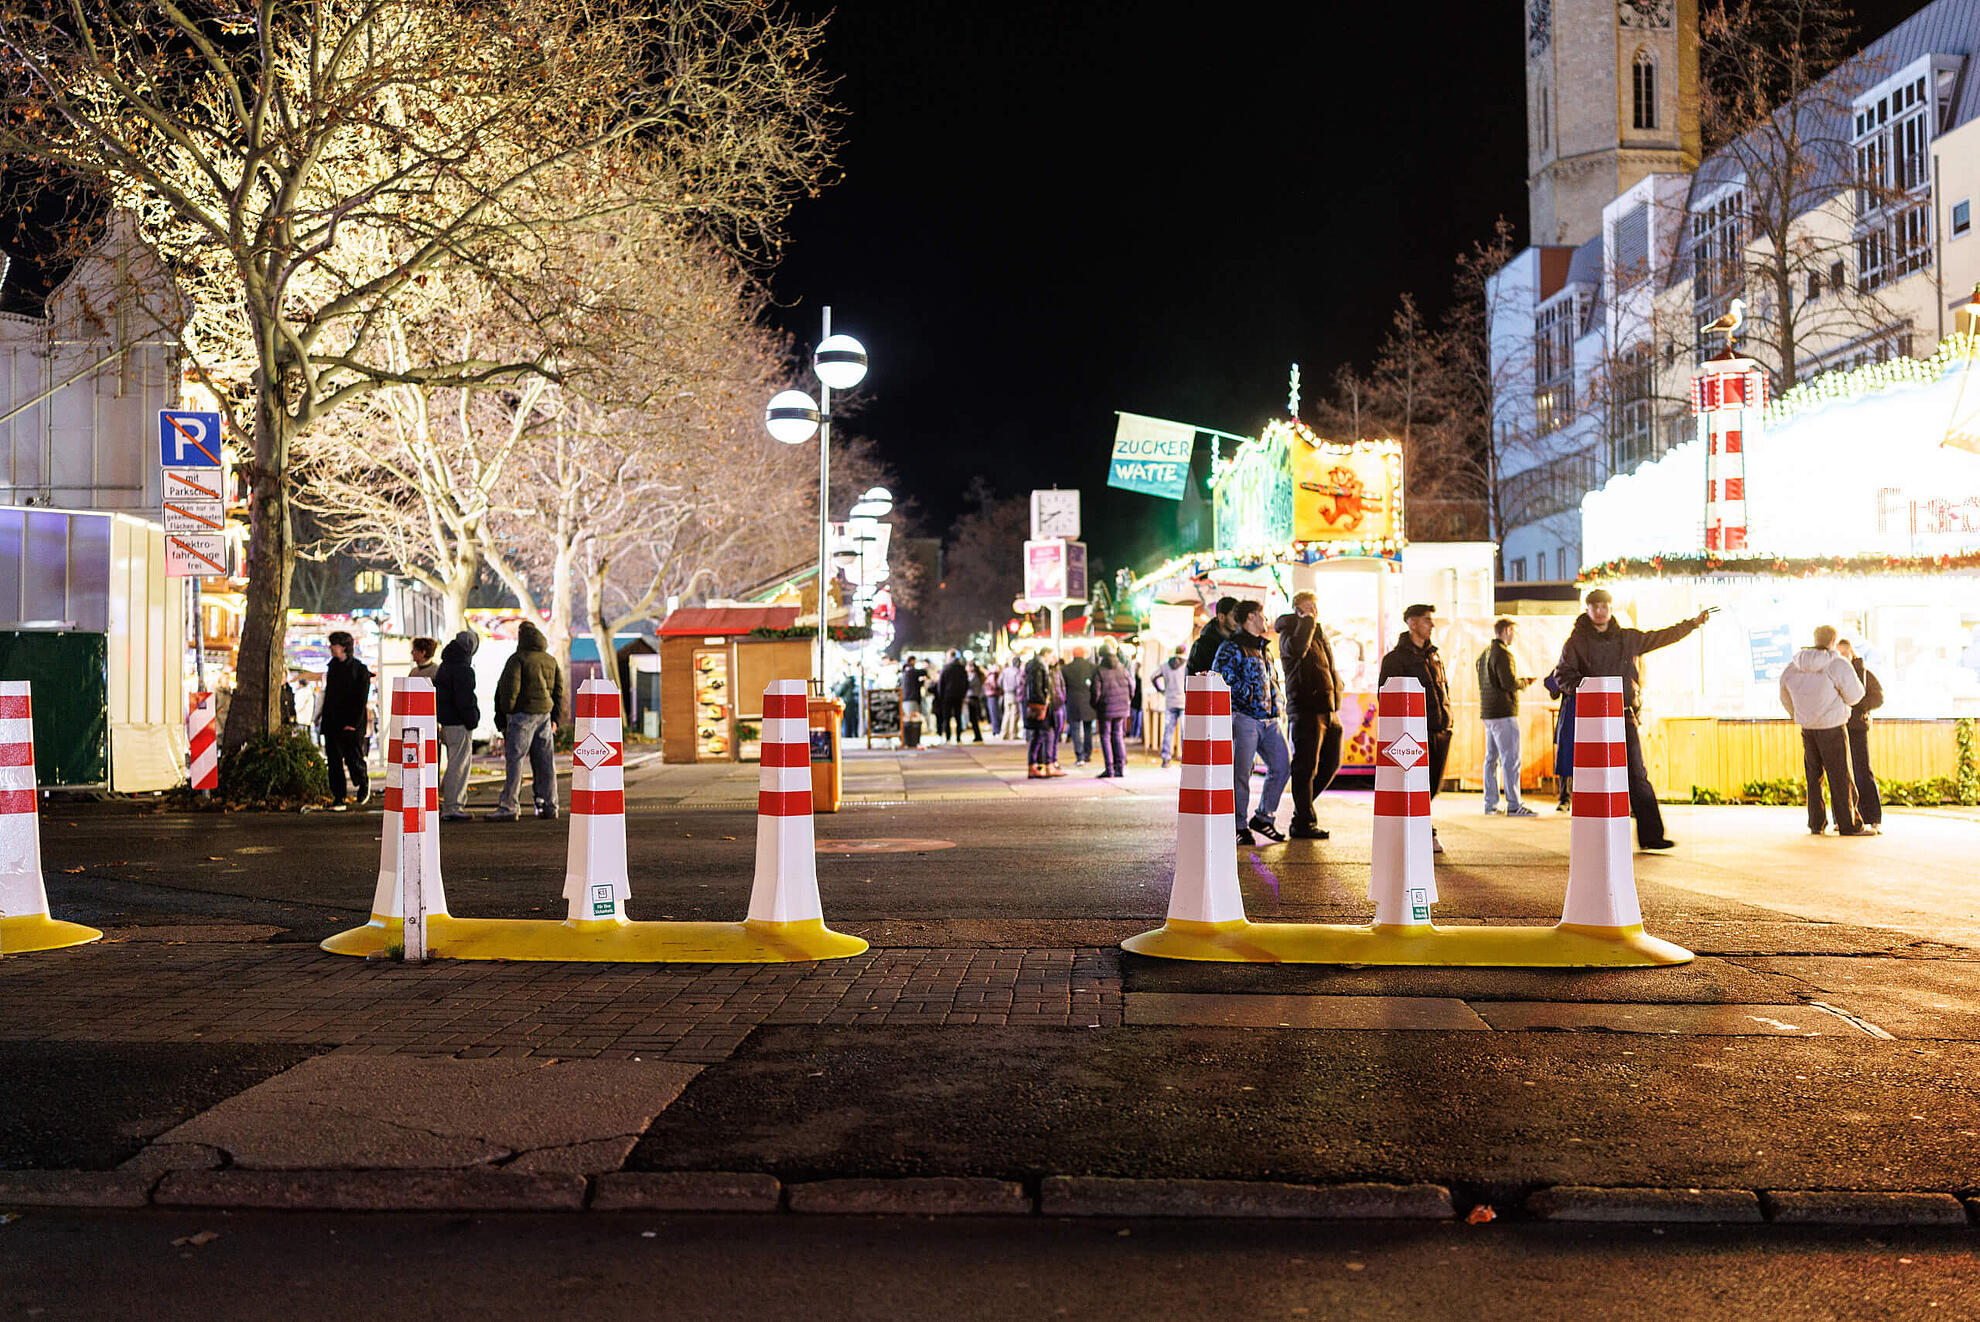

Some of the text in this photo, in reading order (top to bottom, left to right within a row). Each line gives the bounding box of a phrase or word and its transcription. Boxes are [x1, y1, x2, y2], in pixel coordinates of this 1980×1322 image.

[174, 417, 207, 461] P
[1116, 440, 1190, 456] ZUCKER
[1115, 463, 1178, 482] WATTE
[185, 474, 199, 483] mit
[170, 486, 217, 496] Parkschn
[171, 503, 194, 512] ken
[166, 513, 222, 522] gekehneten
[196, 522, 217, 530] erla
[172, 551, 220, 561] fahrzuge
[576, 748, 606, 756] CitySafe
[1391, 748, 1422, 756] CitySafe
